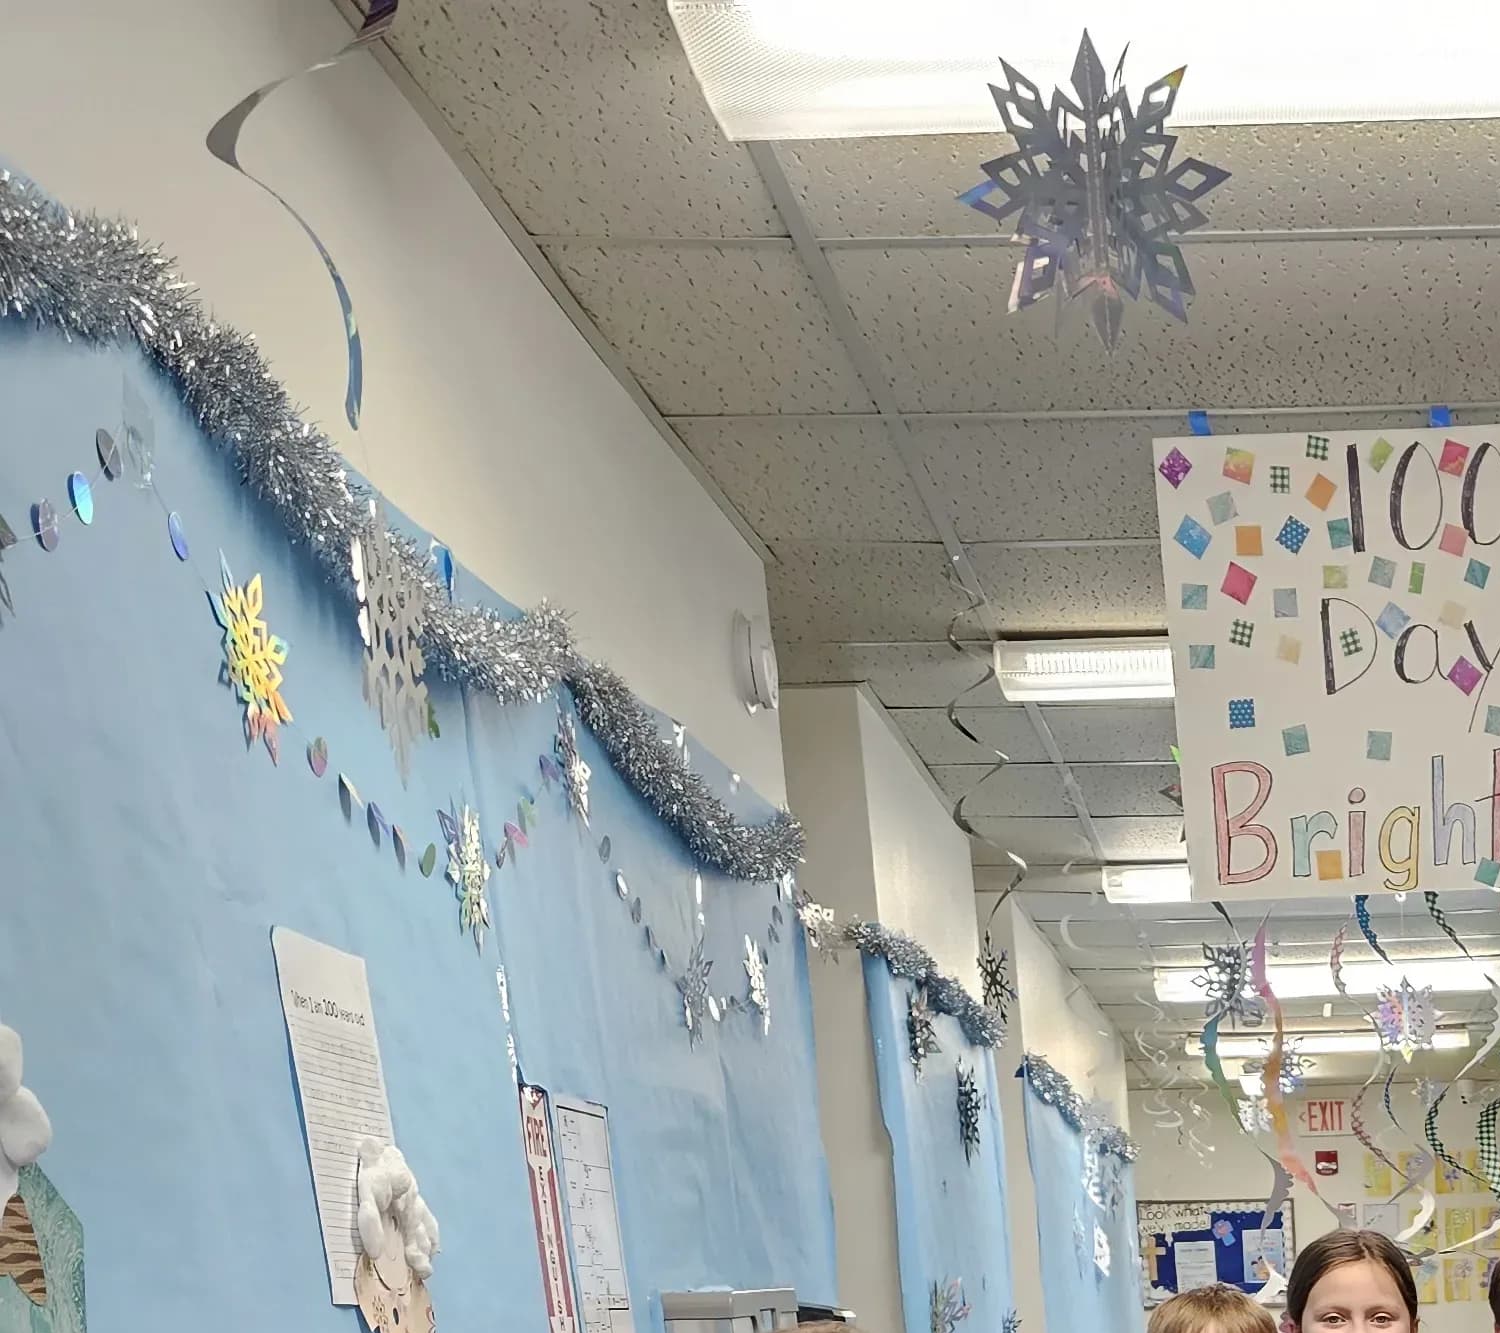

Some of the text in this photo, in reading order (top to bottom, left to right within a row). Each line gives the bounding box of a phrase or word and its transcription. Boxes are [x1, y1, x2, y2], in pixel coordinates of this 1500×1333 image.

[322, 998, 338, 1018] 100
[1307, 1101, 1344, 1131] EXIT
[526, 1115, 547, 1158] FIRE
